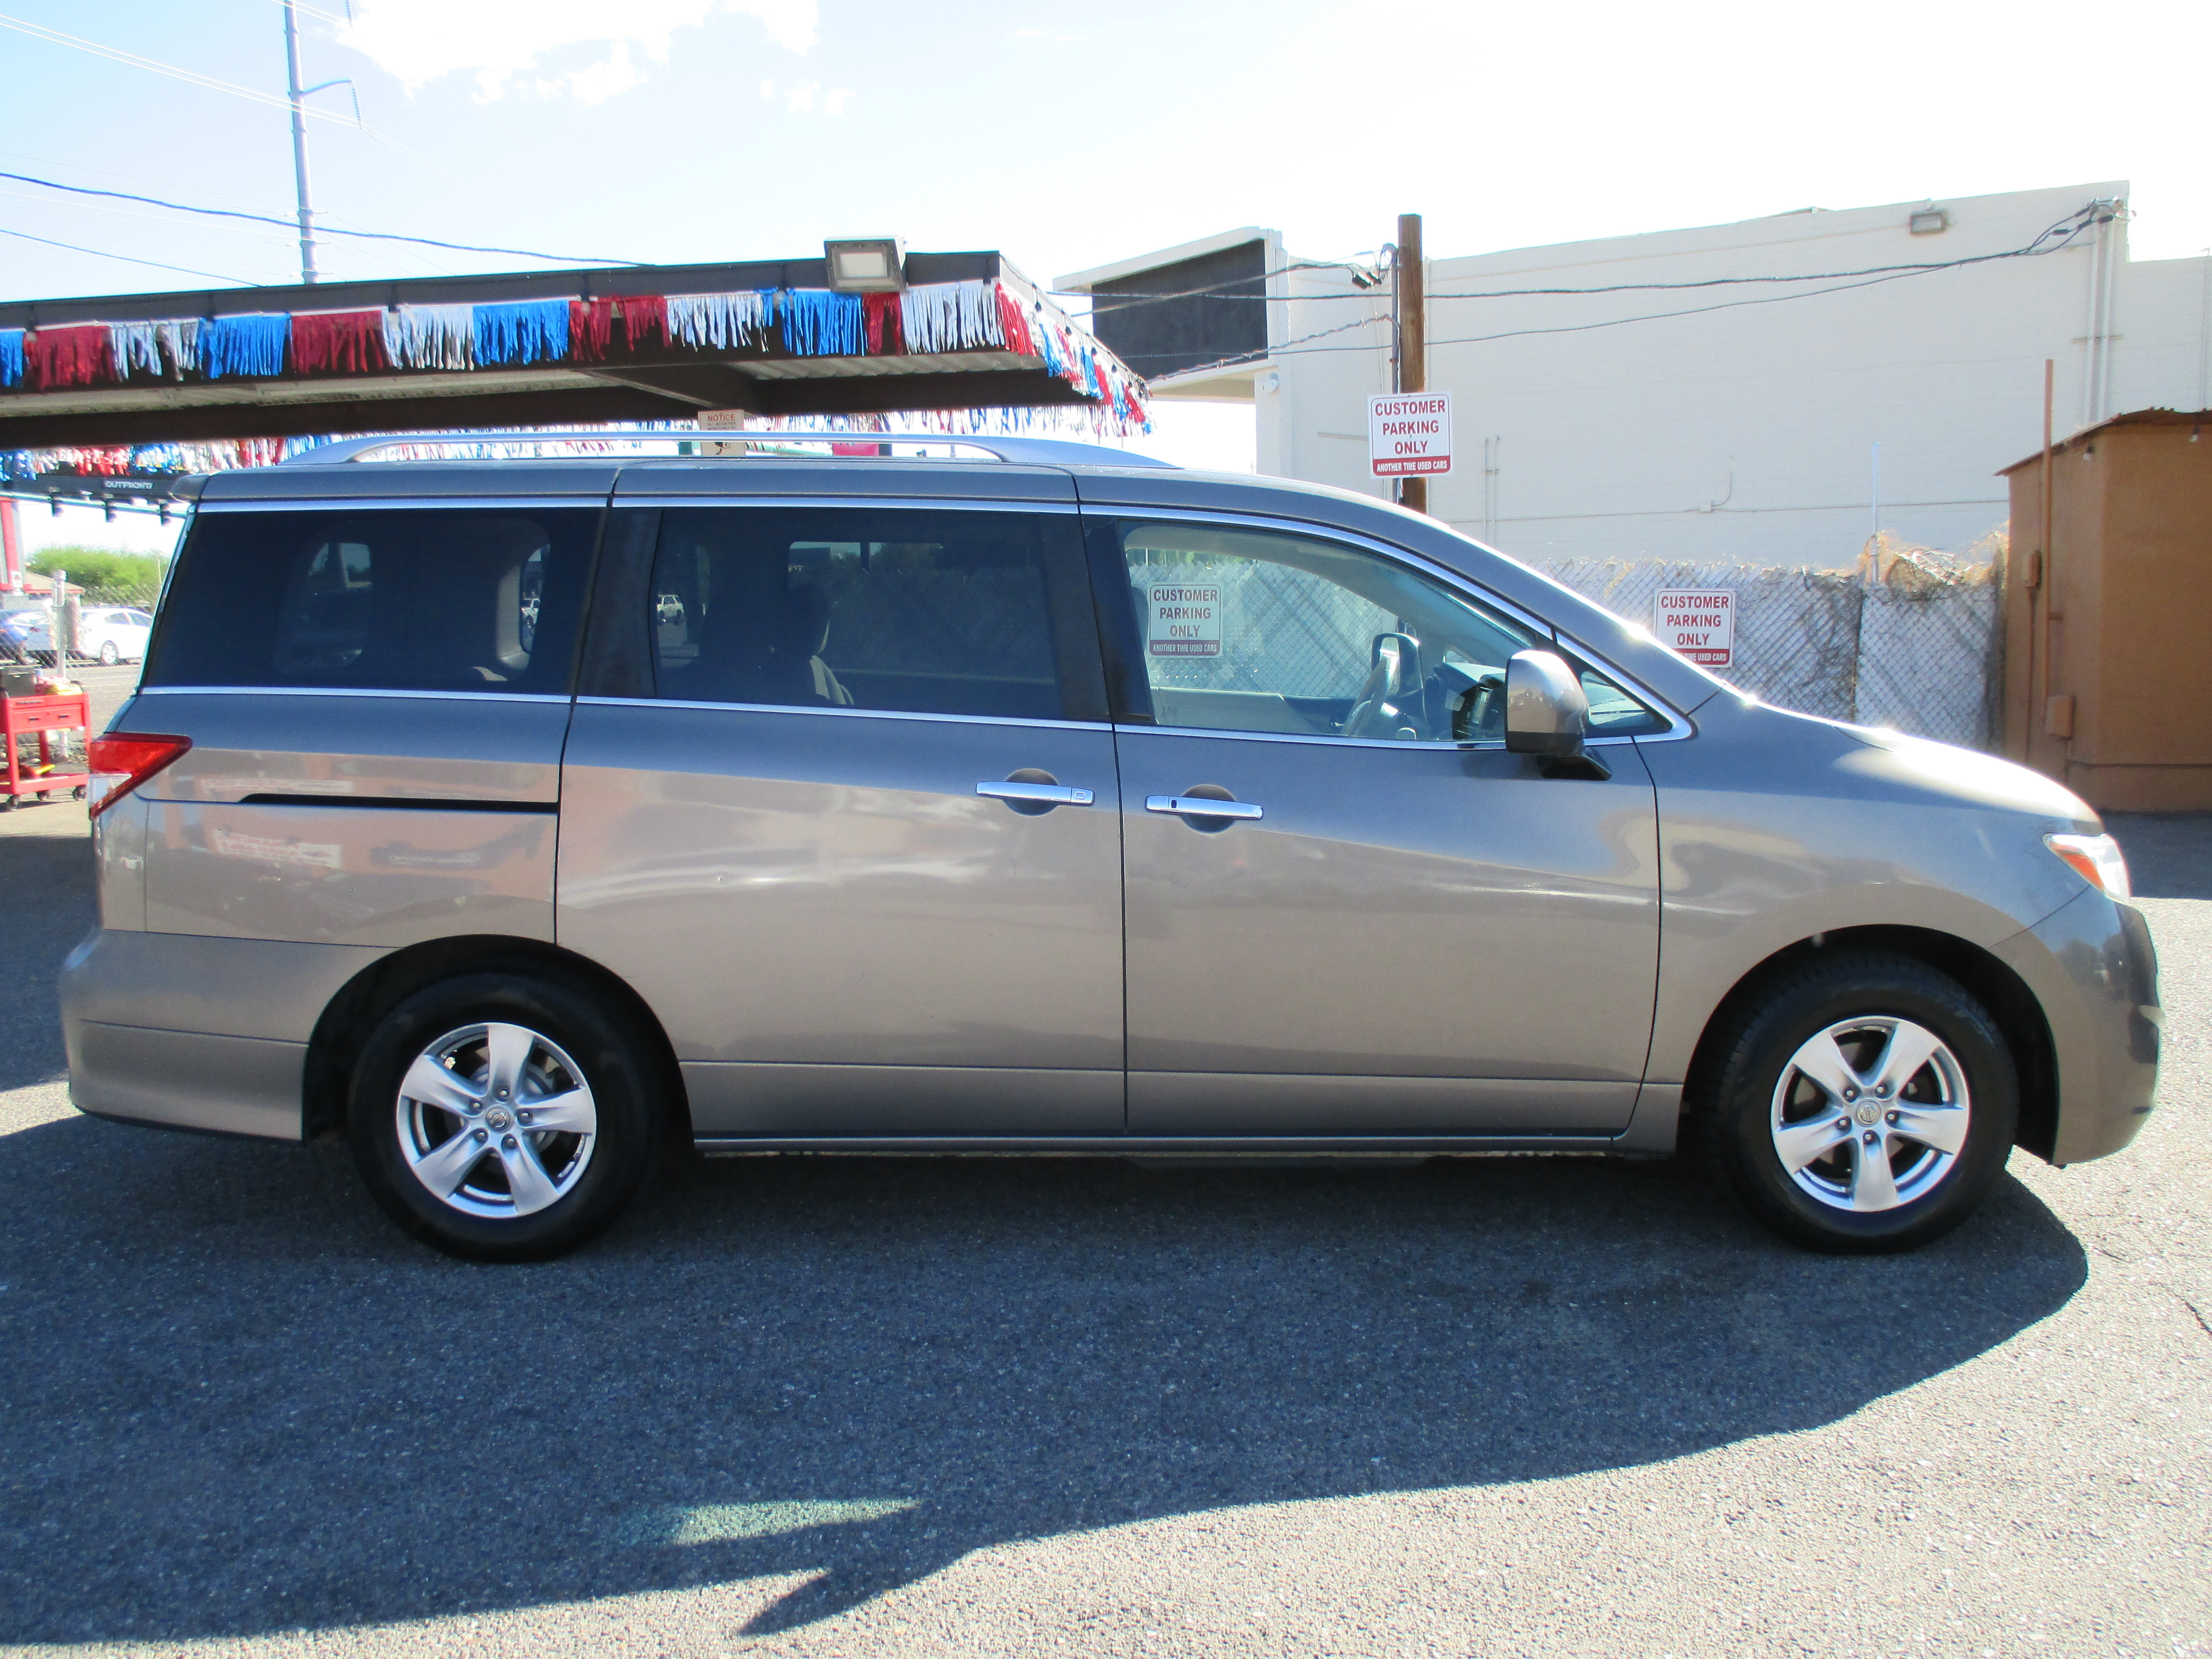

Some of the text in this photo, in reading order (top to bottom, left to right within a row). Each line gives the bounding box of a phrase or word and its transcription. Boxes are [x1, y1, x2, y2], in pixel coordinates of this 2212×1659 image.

[1375, 400, 1445, 416] CUSTOMER
[1382, 420, 1439, 435] PARKING
[1395, 441, 1428, 455] ONLY
[1377, 460, 1447, 472] ANOTHER TIME USED CARS
[1154, 589, 1217, 601] CUSTOMER
[1661, 596, 1729, 608] CUSTOMER
[1160, 607, 1211, 619] PARKING
[1667, 614, 1721, 627] PARKING
[1170, 625, 1200, 637] ONLY
[1677, 633, 1710, 645] ONLY
[1153, 644, 1217, 652] ANOTHER TIME USED CARS
